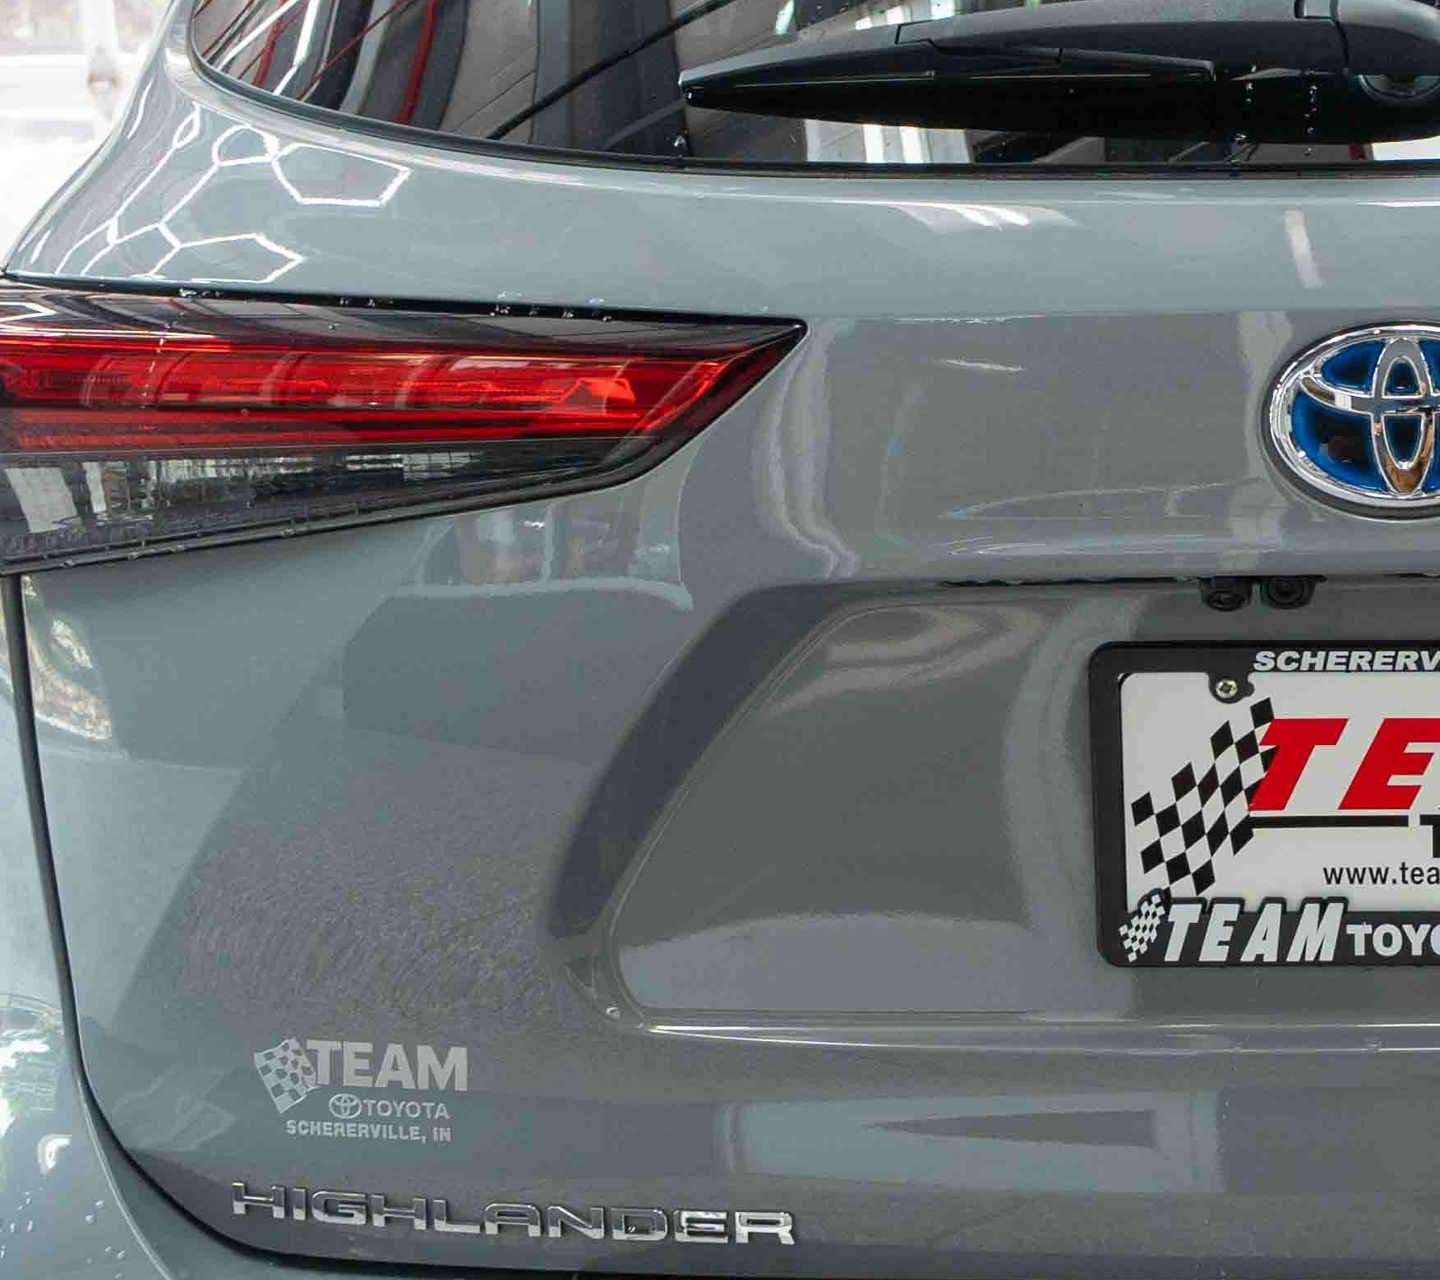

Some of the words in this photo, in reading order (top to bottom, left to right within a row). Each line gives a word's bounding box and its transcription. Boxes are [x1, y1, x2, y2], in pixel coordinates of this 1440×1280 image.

[1163, 902, 1348, 962] TEAM
[307, 1039, 468, 1092] TEAM
[286, 1119, 427, 1143] SCHERERVILLE,
[433, 1127, 452, 1142] IN
[363, 1099, 450, 1120] TOYOTA
[231, 1181, 796, 1246] HIGHLANDER
